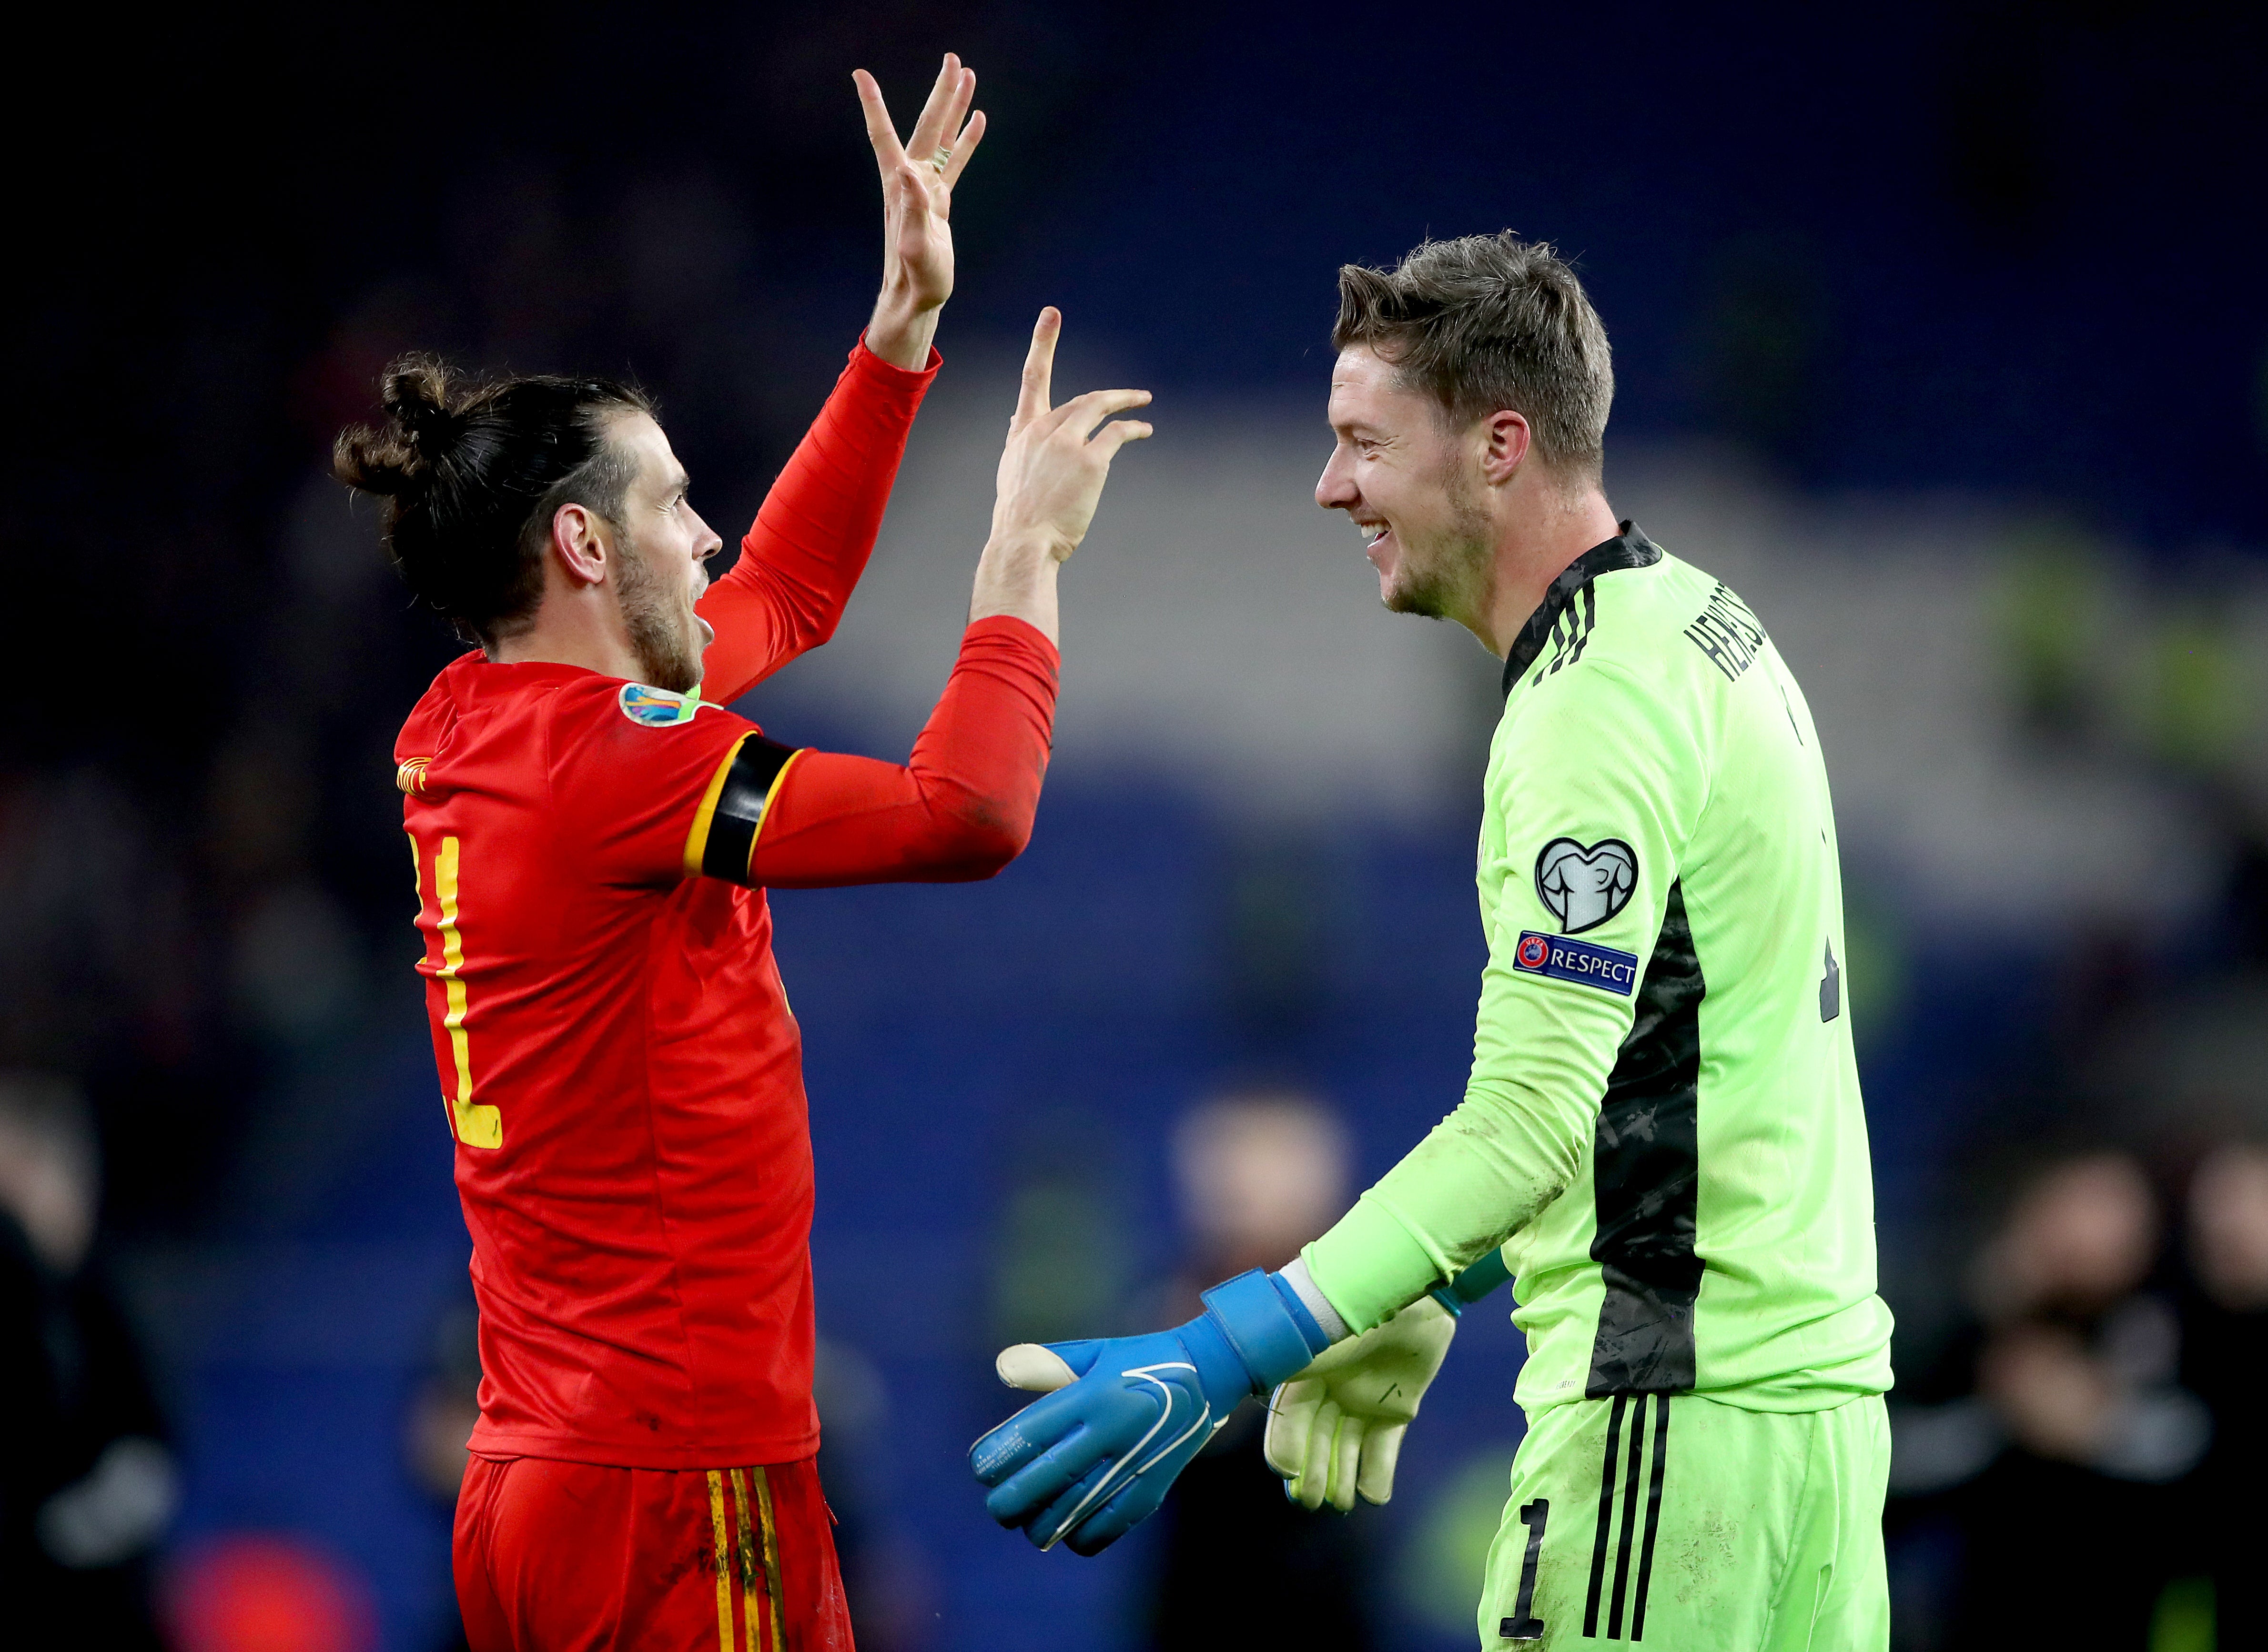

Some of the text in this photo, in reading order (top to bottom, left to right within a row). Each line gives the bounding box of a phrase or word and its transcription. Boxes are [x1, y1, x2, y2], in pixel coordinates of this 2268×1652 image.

[1525, 938, 1544, 947] UEFA
[1551, 948, 1635, 984] RESPECT
[1499, 1498, 1549, 1639] 1
